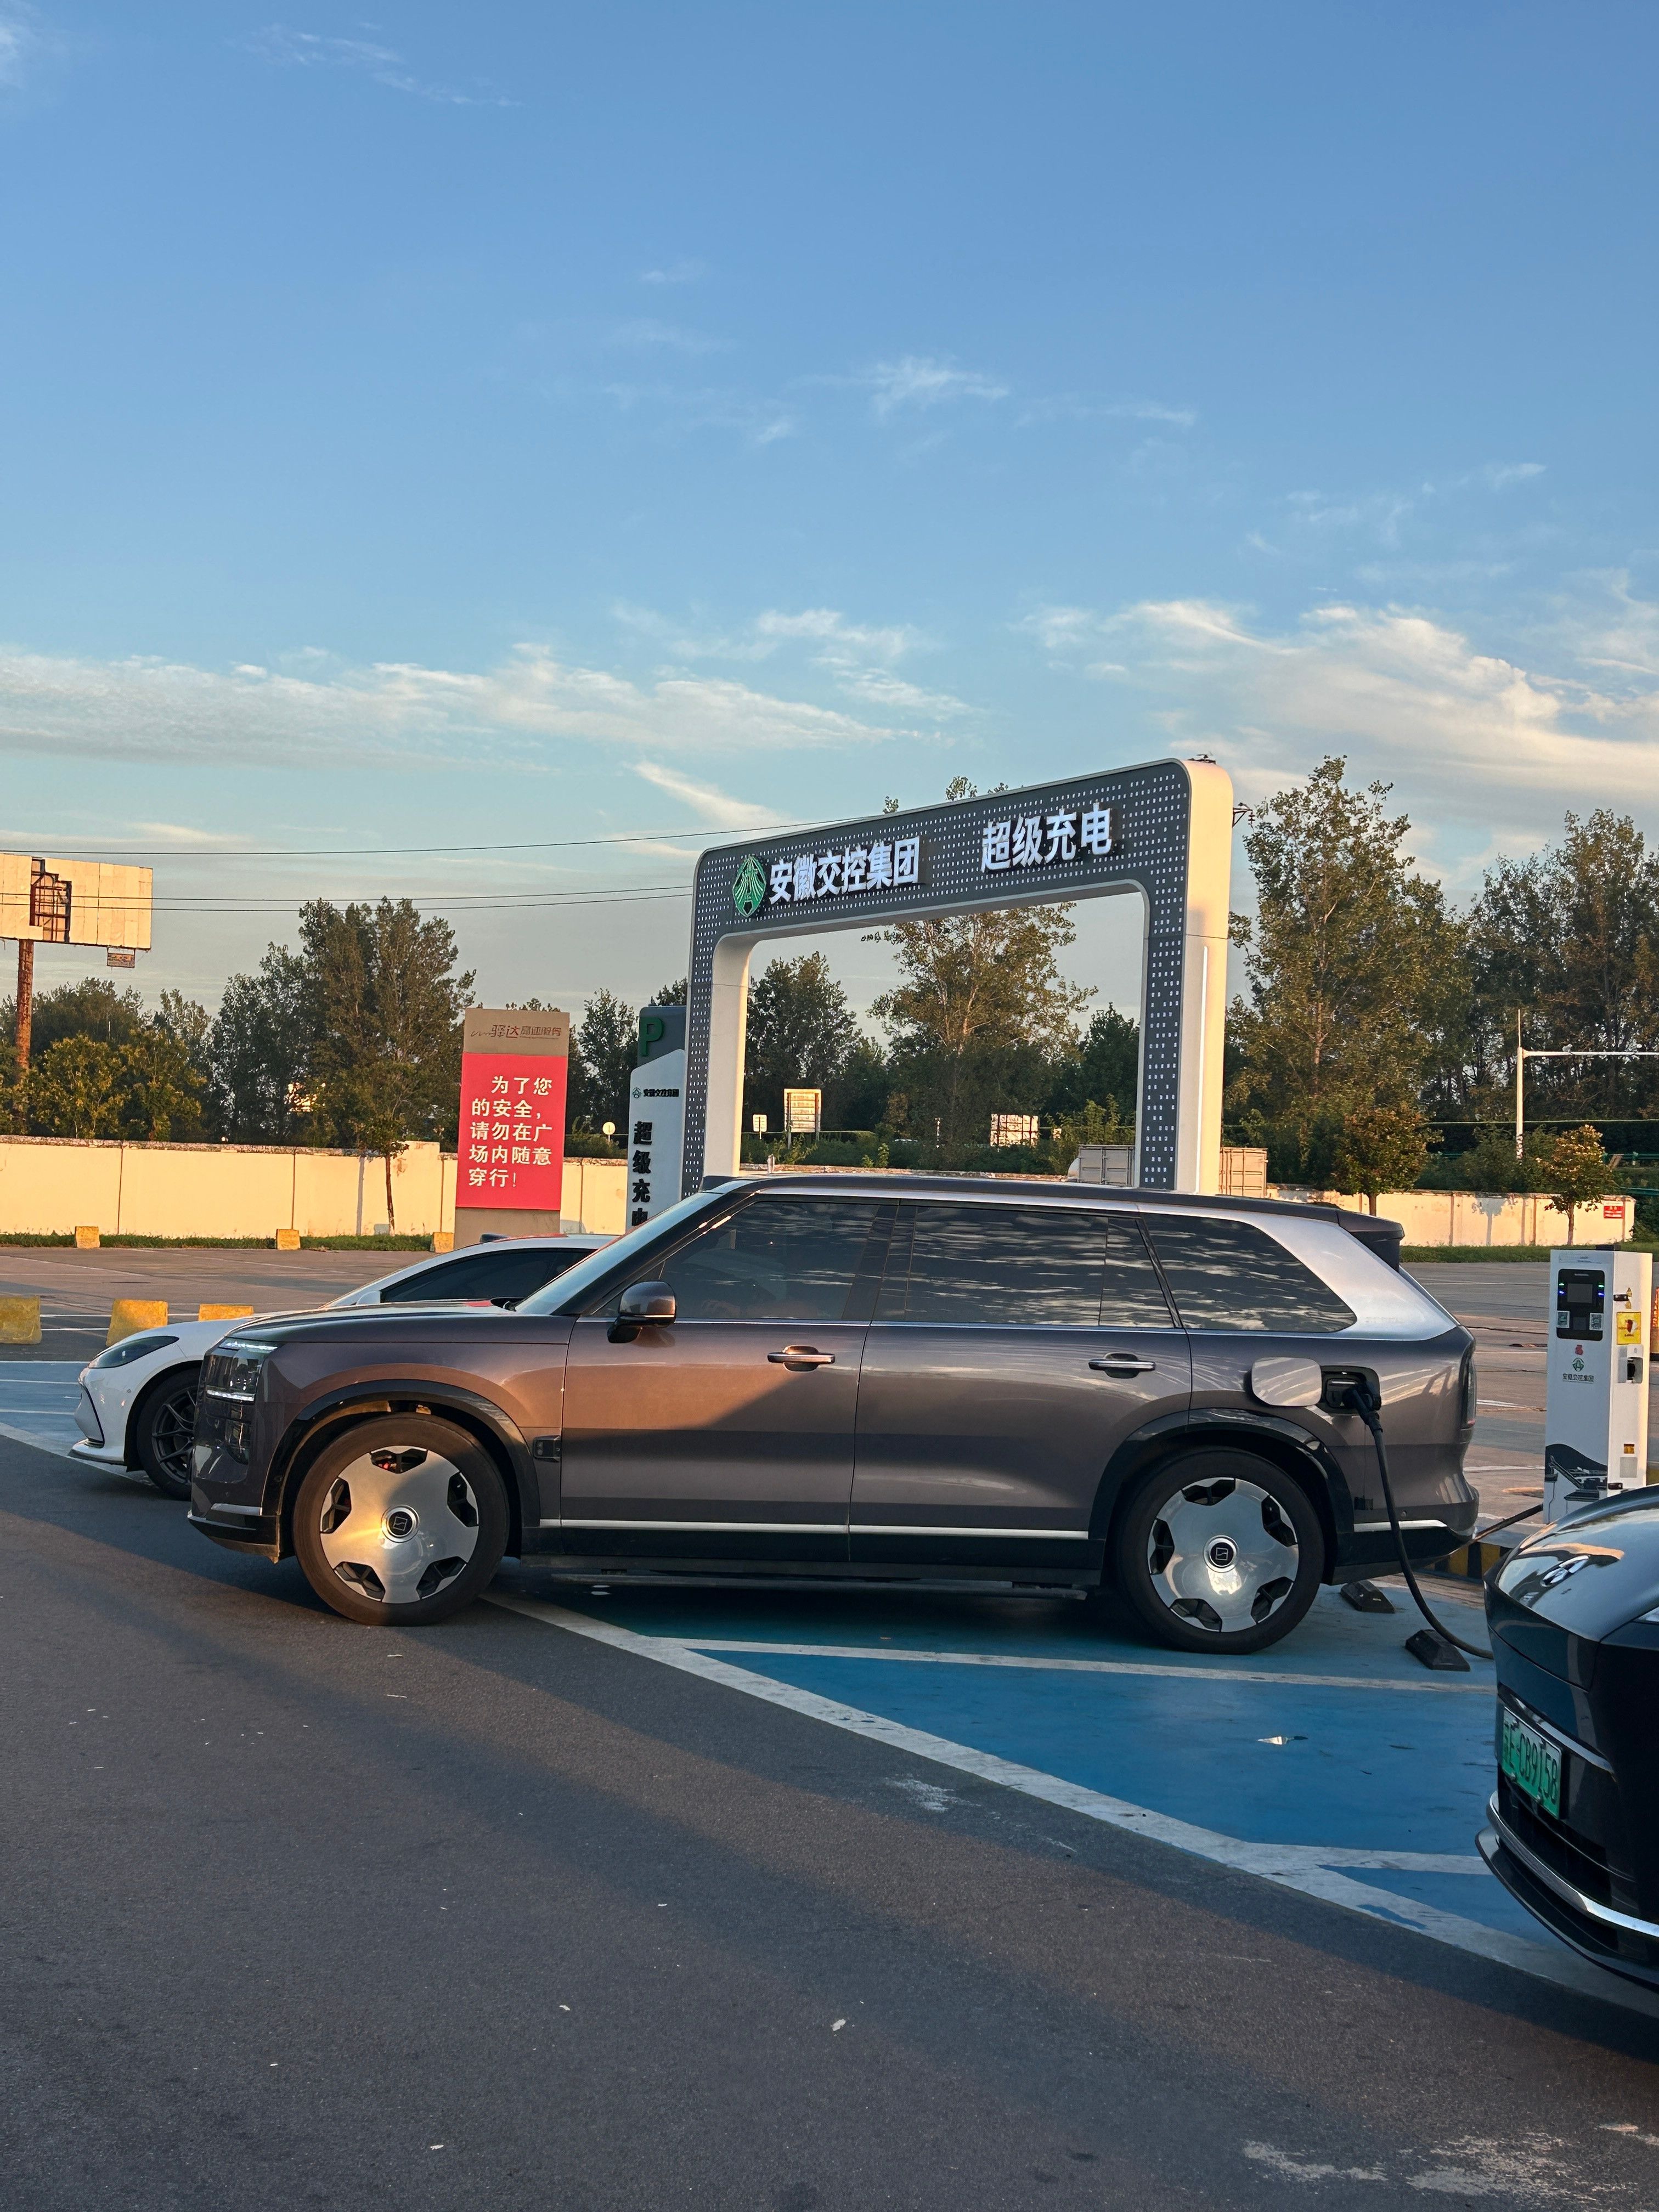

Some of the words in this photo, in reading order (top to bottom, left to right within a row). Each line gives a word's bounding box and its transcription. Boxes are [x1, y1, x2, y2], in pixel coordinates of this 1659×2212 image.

[769, 836, 920, 904] 安徽交控集团
[980, 802, 1112, 873] 超级充电
[640, 1017, 663, 1057] P
[491, 1075, 552, 1096] 为了您
[471, 1098, 541, 1120] 的安全，
[470, 1121, 552, 1142] 请勿在广
[469, 1144, 552, 1165] 场内随意
[469, 1167, 516, 1187] 穿行！
